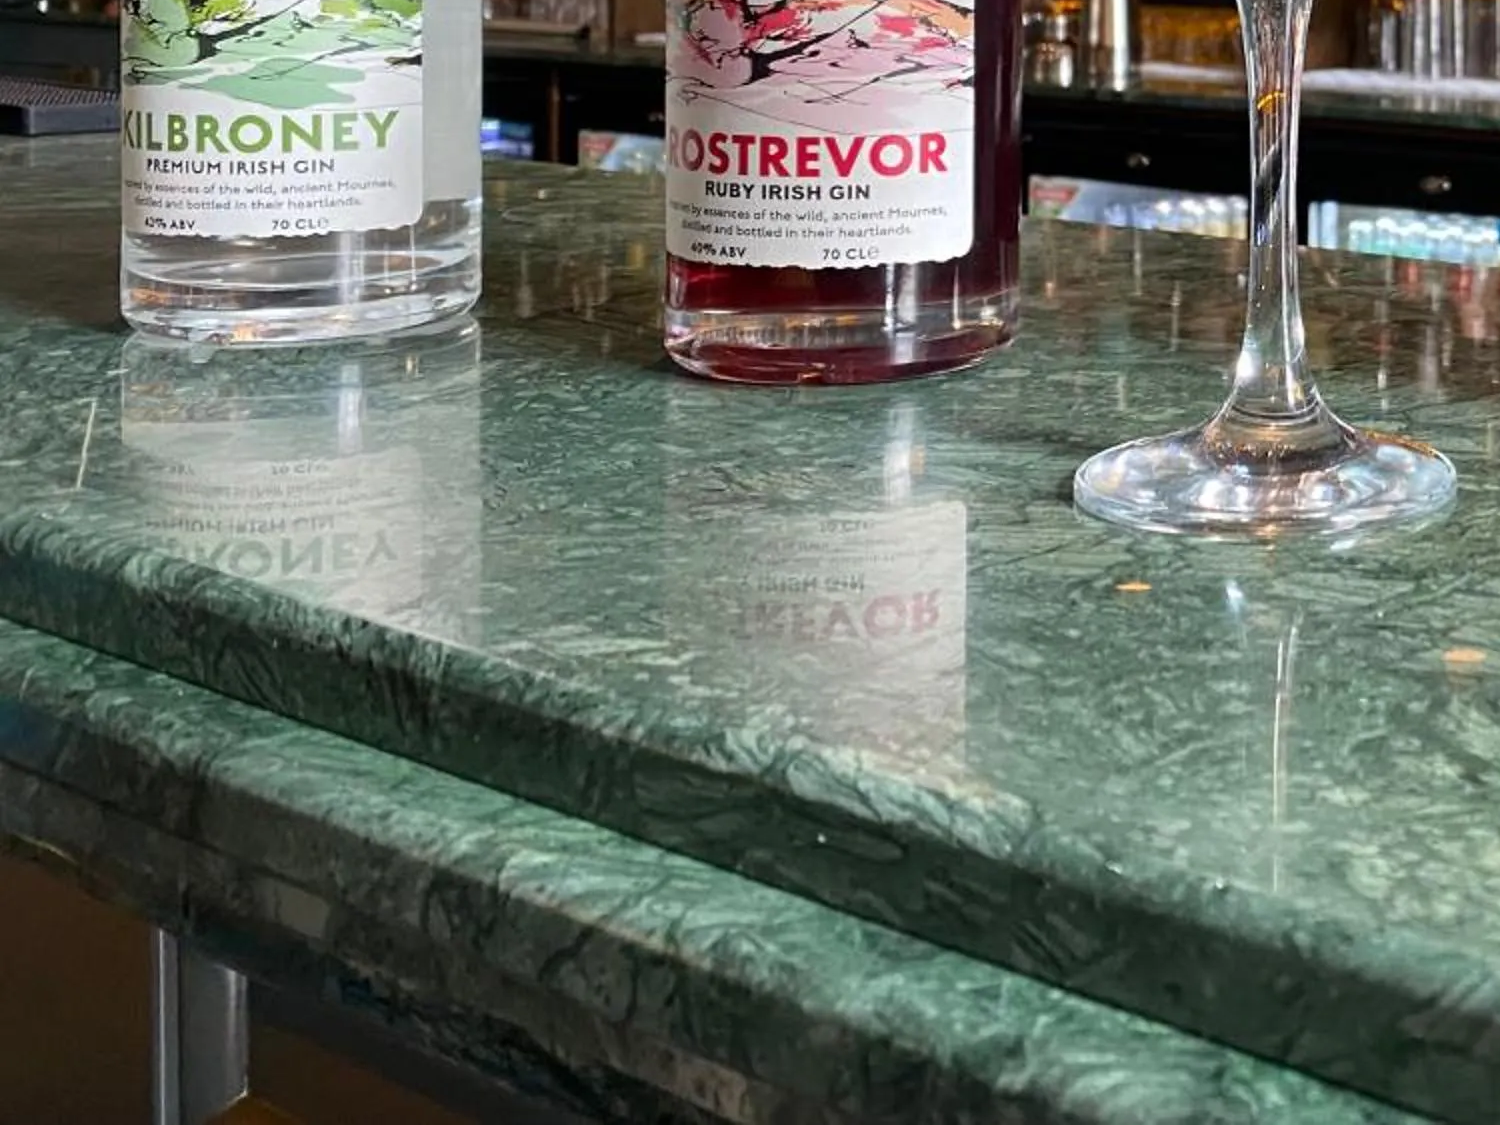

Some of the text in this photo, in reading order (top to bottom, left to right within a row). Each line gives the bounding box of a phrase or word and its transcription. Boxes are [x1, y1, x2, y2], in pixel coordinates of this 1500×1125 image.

[123, 110, 399, 154] KILBRONEY
[669, 127, 948, 178] ROSTREVOR
[146, 158, 336, 175] PREMIUM IRISH GIN
[203, 182, 217, 194] of
[218, 182, 241, 195] the
[244, 182, 277, 196] wild,
[281, 182, 333, 195] ancient
[705, 180, 871, 201] RUBY IRISH GIN
[186, 198, 231, 210] bottled
[250, 198, 284, 210] their
[704, 206, 751, 221] essences
[753, 208, 767, 221] of
[769, 209, 791, 221] the
[796, 208, 829, 223] wild,
[832, 209, 884, 222] ancient
[169, 219, 196, 230] ABV
[271, 219, 291, 231] 70
[713, 225, 733, 236] and
[735, 226, 782, 238] bottled
[785, 228, 798, 238] in
[801, 227, 835, 239] their
[719, 246, 747, 258] ABV
[823, 248, 841, 260] 70
